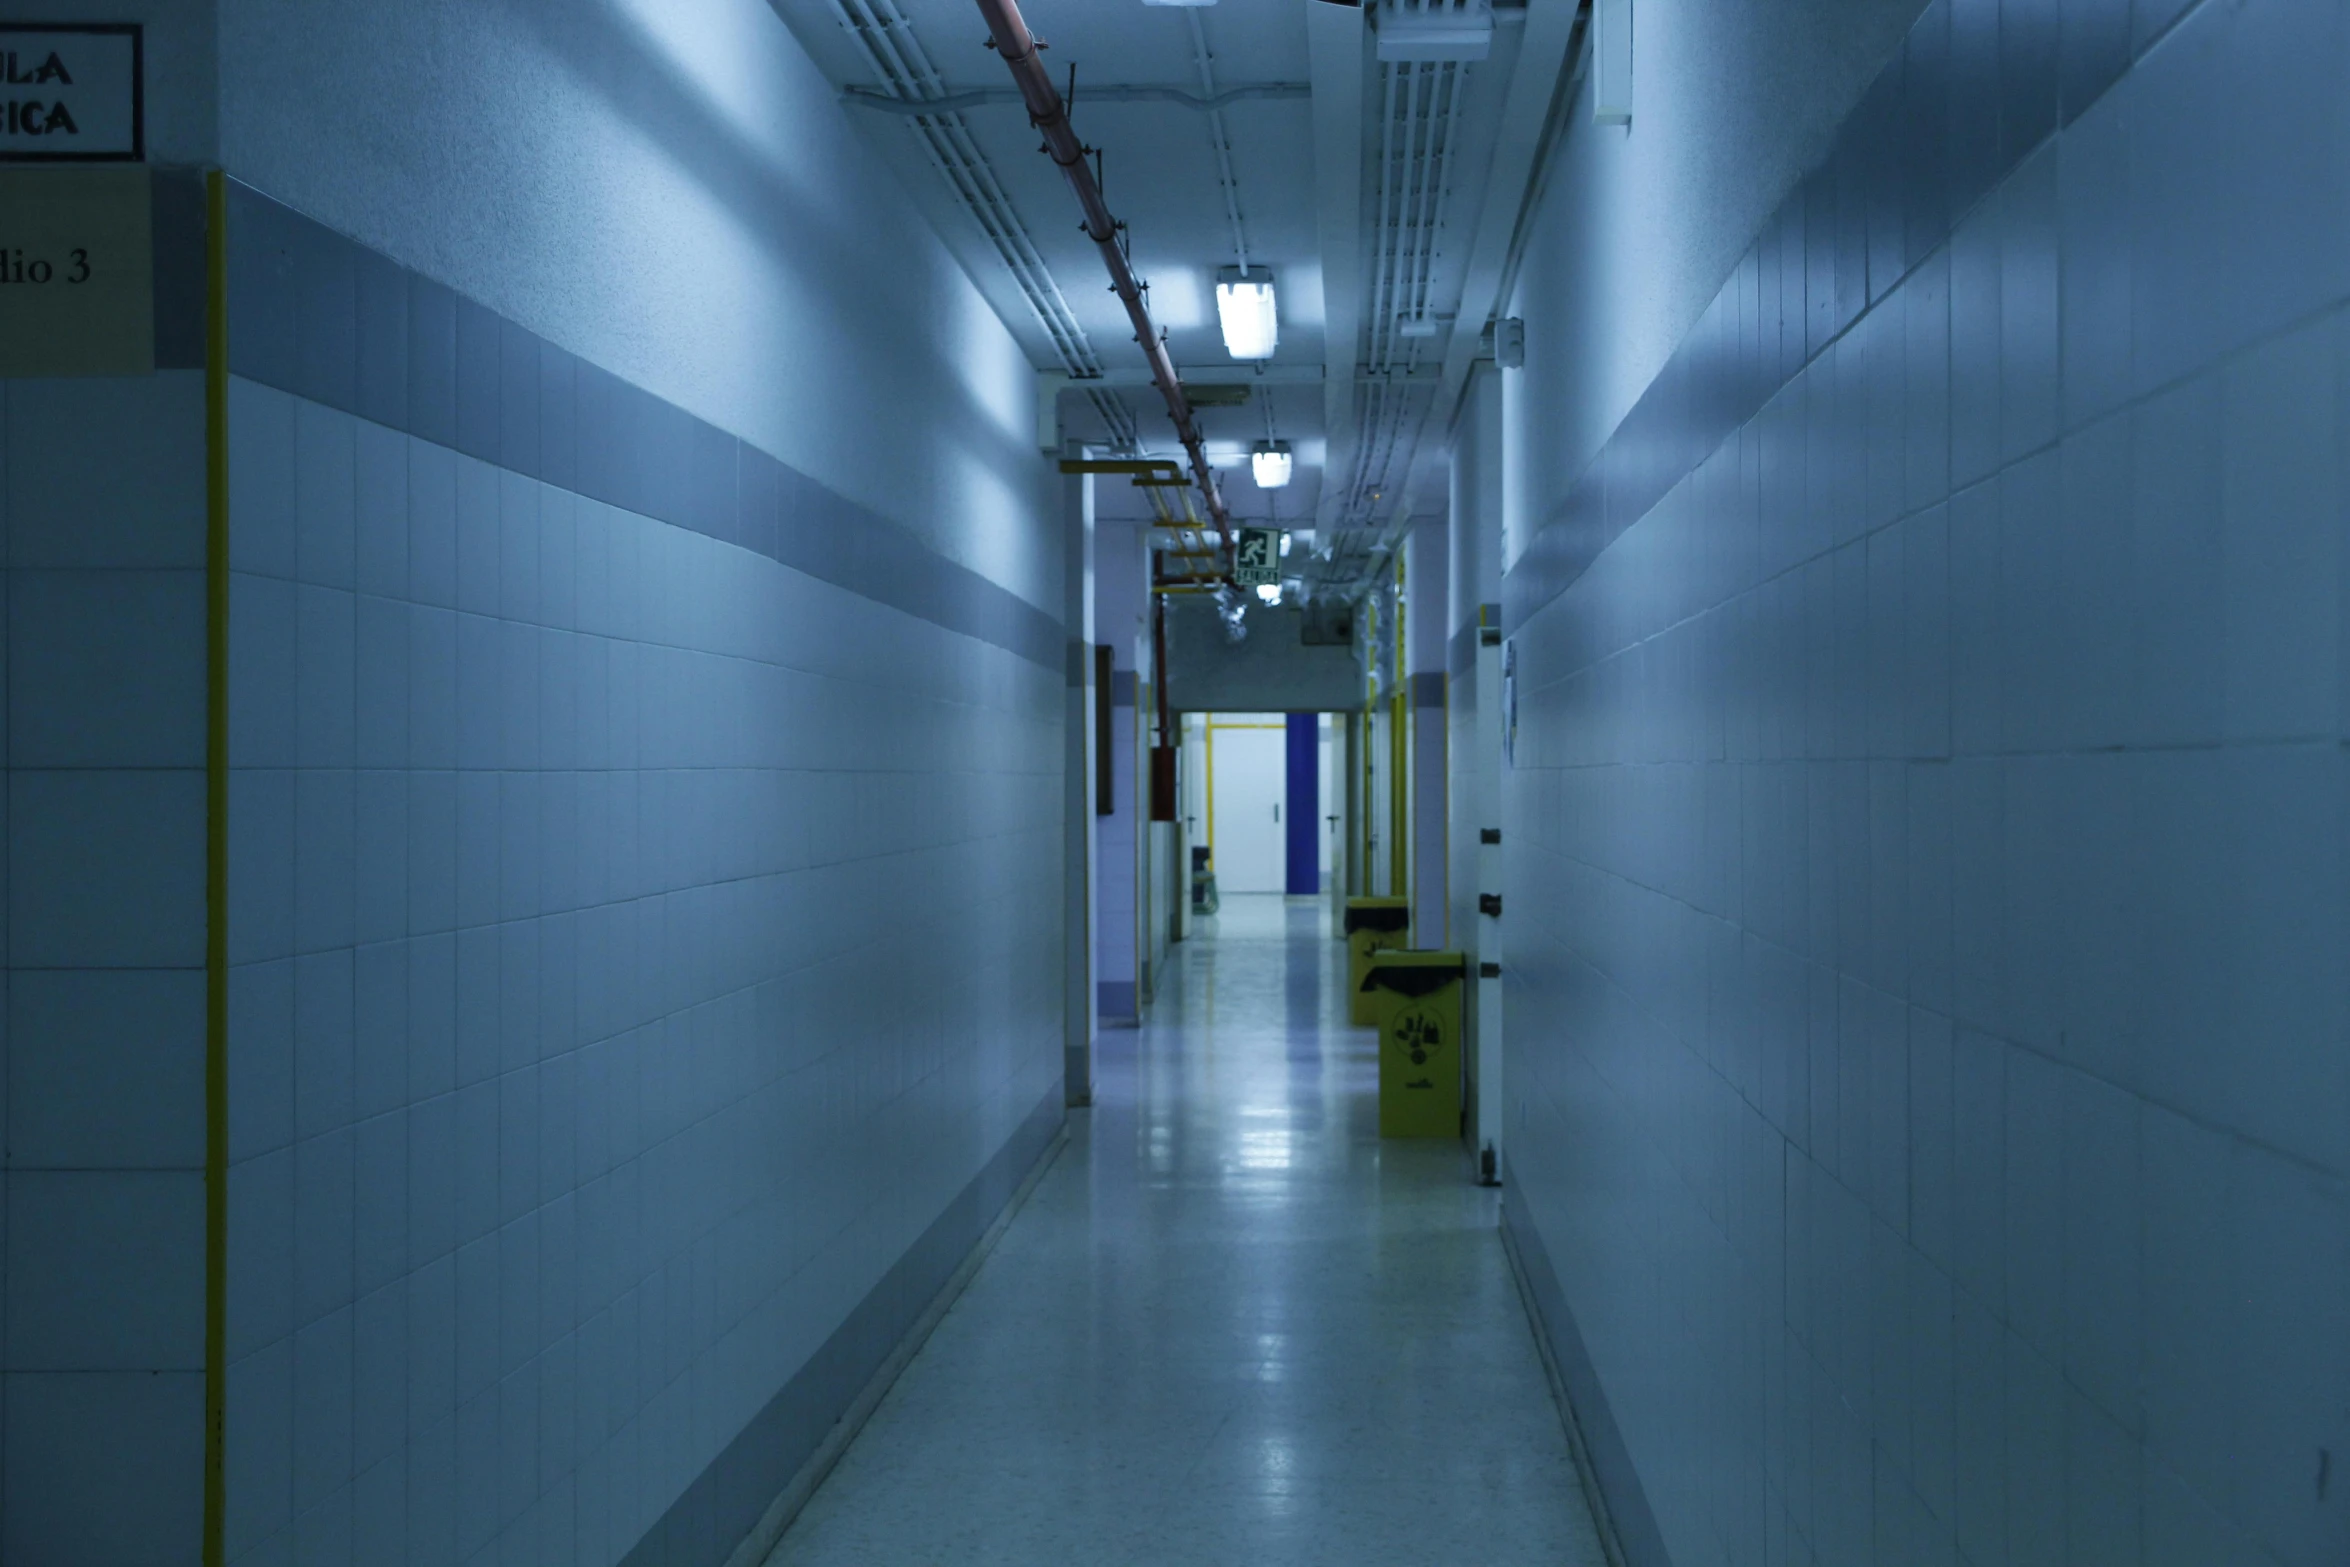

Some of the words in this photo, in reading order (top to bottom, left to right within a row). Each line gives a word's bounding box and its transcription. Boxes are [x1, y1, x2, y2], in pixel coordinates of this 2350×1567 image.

[0, 51, 73, 84] LA
[0, 100, 79, 135] ICA
[67, 248, 90, 284] 3
